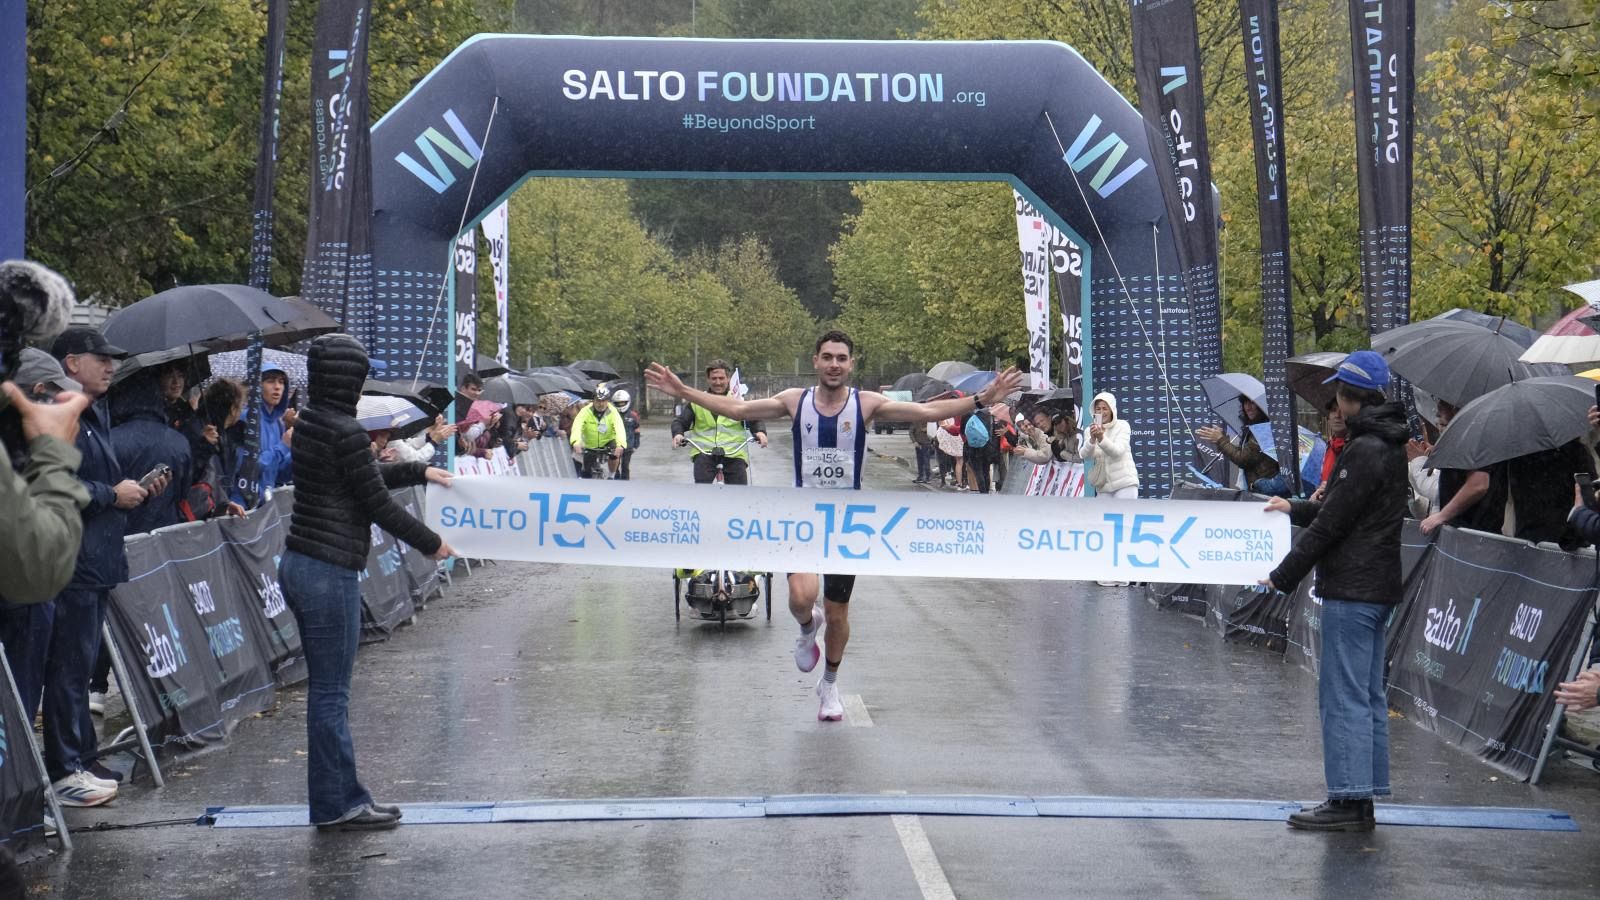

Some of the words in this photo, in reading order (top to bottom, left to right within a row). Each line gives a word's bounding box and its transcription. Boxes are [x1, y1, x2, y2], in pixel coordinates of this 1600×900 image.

[562, 69, 686, 101] SALTO
[697, 71, 944, 102] FOUNDATION
[951, 89, 986, 107] .org
[682, 113, 816, 132] #BeyondSport
[812, 466, 844, 478] 409
[440, 506, 527, 531] SALTO
[631, 508, 700, 522] DONOSTIA
[672, 521, 700, 533] SAN
[727, 518, 814, 543] SALTO
[916, 518, 984, 532] DONOSTIA
[624, 531, 700, 545] SEBASTIAN
[956, 532, 985, 544] SAN
[1018, 528, 1104, 552] SALTO
[1205, 527, 1273, 540] DONOSTIA
[909, 541, 985, 555] SEBASTIAN
[1245, 540, 1273, 551] SAN
[1198, 550, 1274, 562] SEBASTIAN
[1423, 598, 1461, 651] salto
[1509, 602, 1543, 643] SALTO
